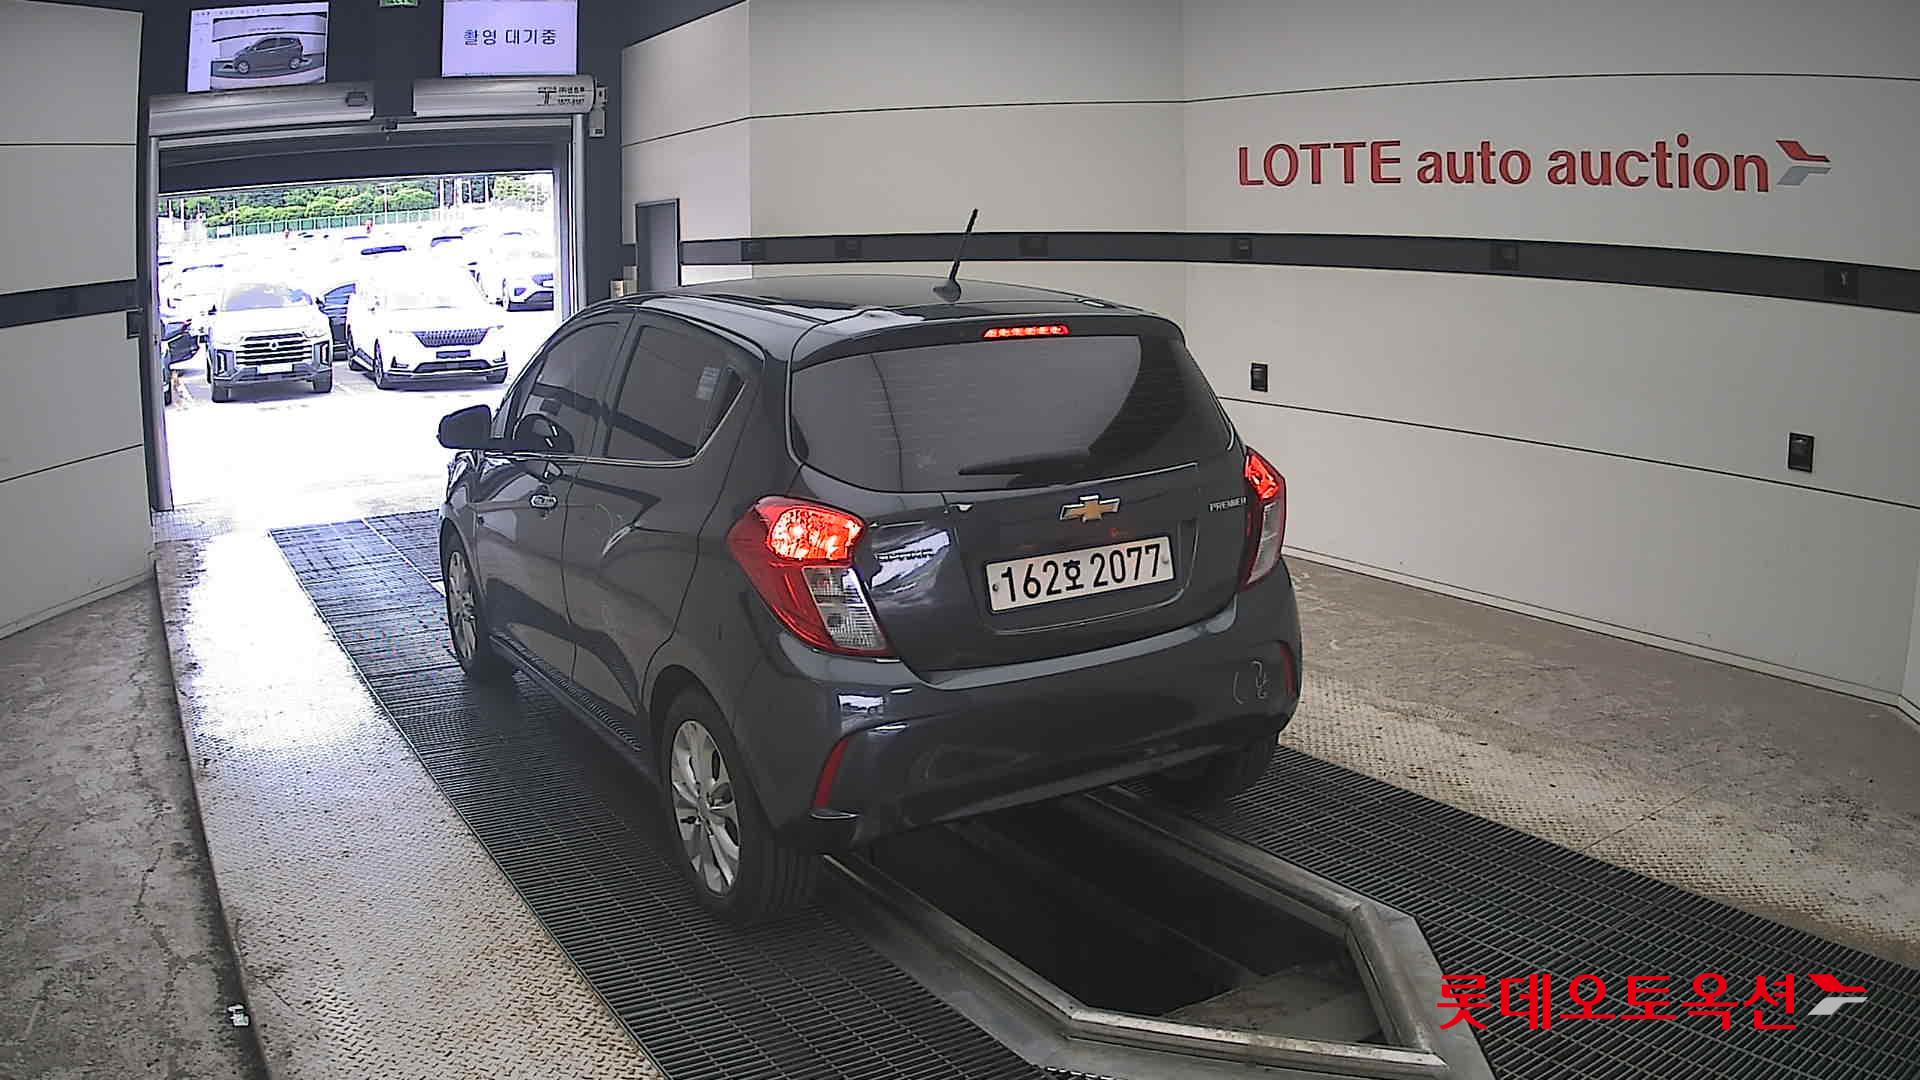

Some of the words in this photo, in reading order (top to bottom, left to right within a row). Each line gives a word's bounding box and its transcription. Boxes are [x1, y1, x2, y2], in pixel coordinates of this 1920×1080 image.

[505, 28, 556, 46] 대기중
[1238, 141, 1400, 188] LOTTE
[1417, 140, 1533, 186] auto
[1548, 134, 1770, 193] auction
